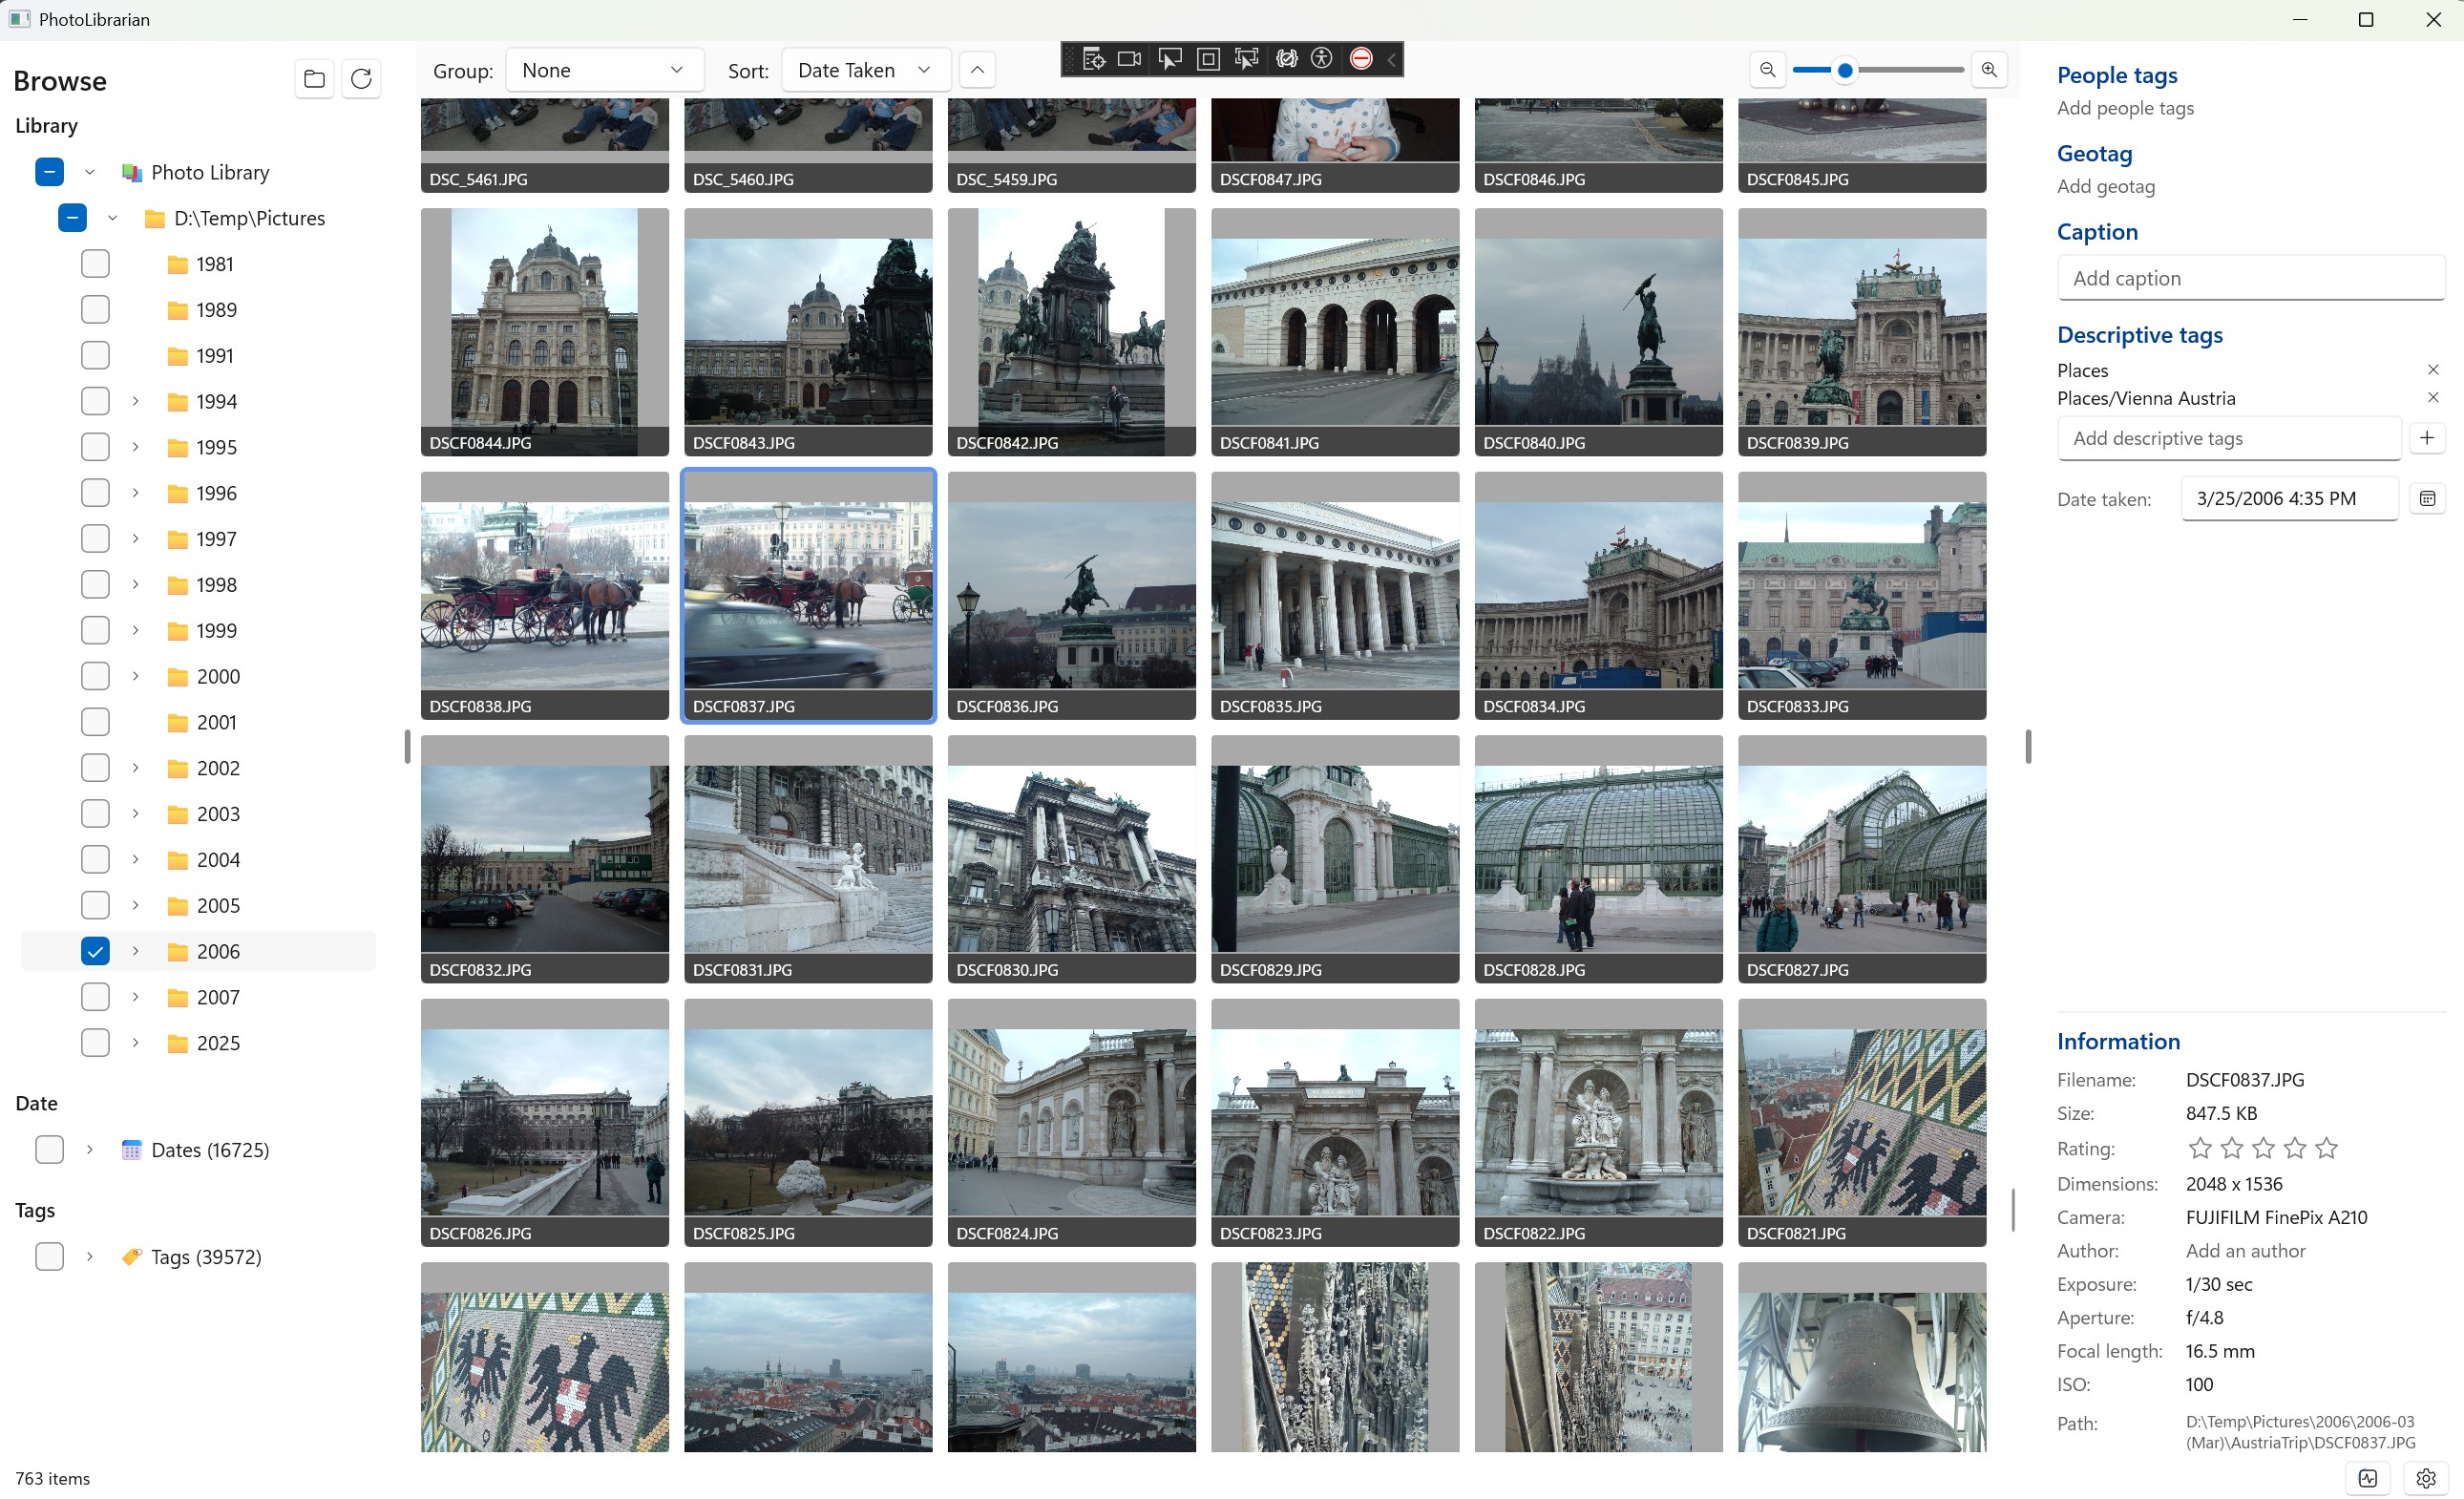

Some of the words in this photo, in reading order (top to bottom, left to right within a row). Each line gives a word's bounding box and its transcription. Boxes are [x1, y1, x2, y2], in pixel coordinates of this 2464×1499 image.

[39, 11, 150, 27] PhotoLibrarian
[433, 63, 494, 84] Group:
[523, 62, 571, 78] None
[728, 63, 769, 79] Sort:
[799, 62, 840, 78] Date
[844, 61, 895, 78] Taken
[2058, 65, 2128, 90] People
[2133, 67, 2179, 90] tags
[14, 70, 108, 92] Browse
[2056, 99, 2092, 116] Add
[2097, 99, 2155, 120] people
[2159, 101, 2195, 120] tags
[15, 116, 79, 138] Library
[2057, 144, 2133, 168] Geotag
[152, 163, 204, 180] Photo
[210, 162, 270, 185] Library
[430, 173, 528, 188] DSC_5461.JPG
[693, 173, 794, 188] DSC_5460.JPG
[957, 173, 1058, 188] DSC_5459.JPG
[1220, 173, 1322, 186] DSCF0847.JPG
[1484, 173, 1586, 186] DSCF0846.JPG
[1747, 173, 1849, 186] DSCF0845.JPG
[2056, 178, 2092, 194] Add
[2096, 179, 2156, 199] geotag
[175, 208, 326, 231] D:\Temp\Pictures
[2057, 222, 2138, 246] Caption
[197, 256, 233, 272] 1981
[2073, 269, 2110, 286] Add
[2116, 268, 2181, 291] caption
[197, 302, 238, 318] 1989
[2058, 325, 2174, 349] Descriptive
[2179, 327, 2224, 349] tags
[197, 348, 233, 364] 1991
[2057, 362, 2109, 378] Places
[197, 393, 238, 410] 1994
[2057, 390, 2173, 408] Places/Vienna
[2178, 391, 2236, 406] Austria
[197, 439, 238, 455] 1995
[430, 436, 532, 450] DSCF0844.JPG
[693, 436, 795, 450] DSCF0843.JPG
[957, 436, 1059, 450] DSCF0842.JPG
[1220, 436, 1319, 450] DSCF0841.JPG
[1484, 436, 1586, 450] DSCF0840.JPG
[1747, 436, 1849, 450] DSCF0839.JPG
[2073, 430, 2108, 446] Add
[2113, 430, 2203, 451] descriptive
[2207, 432, 2243, 451] tags
[197, 485, 238, 501] 1996
[2058, 492, 2096, 507] Date
[2101, 491, 2152, 507] taken:
[2197, 491, 2285, 508] 3/25/2006
[2288, 491, 2325, 506] 4:35
[2329, 491, 2356, 506] PM
[197, 531, 238, 547] 1997
[197, 577, 238, 593] 1998
[197, 623, 238, 639] 1999
[197, 668, 241, 685] 2000
[430, 700, 532, 713] DSCF0838.JPG
[693, 700, 795, 713] DSCF0837.JPG
[957, 700, 1059, 713] DSCF0836.JPG
[1220, 700, 1322, 713] DSCF0835.JPG
[1484, 700, 1586, 713] DSCF0834.JPG
[1747, 700, 1849, 713] DSCF0833.JPG
[197, 714, 236, 730] 2001
[197, 760, 241, 776] 2002
[197, 806, 241, 822] 2003
[197, 852, 242, 868] 2004
[197, 897, 241, 914] 2005
[197, 943, 241, 960] 2006
[430, 963, 532, 977] DSCF0832.JPG
[693, 963, 792, 977] DSCF0831.JPG
[957, 963, 1059, 977] DSCF0830.JPG
[1220, 963, 1322, 977] DSCF0829.JPG
[1484, 963, 1586, 977] DSCF0828.JPG
[1747, 963, 1849, 977] DSCF0827.JPG
[197, 989, 241, 1005] 2007
[197, 1035, 241, 1051] 2025
[2058, 1031, 2180, 1050] Information
[2057, 1071, 2136, 1087] Filename:
[2186, 1072, 2305, 1087] DSCF0837.JPG
[15, 1095, 58, 1111] Date
[2057, 1106, 2095, 1121] Size:
[2186, 1106, 2231, 1121] 847.5
[2236, 1106, 2258, 1121] KB
[152, 1142, 201, 1158] Dates
[207, 1142, 270, 1161] (16725)
[2057, 1141, 2116, 1161] Rating:
[2058, 1176, 2159, 1192] Dimensions:
[2186, 1176, 2227, 1192] 2048
[2231, 1180, 2242, 1192] x
[2244, 1176, 2284, 1192] 1536
[14, 1202, 55, 1223] Tags
[2057, 1210, 2125, 1225] Camera:
[2186, 1210, 2260, 1225] FUJIFILM
[2265, 1210, 2324, 1225] FinePix
[2327, 1210, 2369, 1225] A210
[430, 1227, 532, 1240] DSCF0826.JPG
[693, 1227, 795, 1240] DSCF0825.JPG
[957, 1227, 1059, 1240] DSCF0824.JPG
[1220, 1227, 1322, 1240] DSCF0823.JPG
[1484, 1227, 1586, 1240] DSCF0822.JPG
[1747, 1227, 1846, 1240] DSCF0821.JPG
[2056, 1242, 2119, 1258] Author:
[2185, 1242, 2221, 1258] Add
[2225, 1247, 2245, 1258] an
[2251, 1242, 2306, 1258] author
[151, 1249, 191, 1270] Tags
[196, 1249, 262, 1268] (39572)
[2058, 1277, 2137, 1297] Exposure:
[2185, 1277, 2222, 1294] 1/30
[2225, 1280, 2253, 1292] sec
[2056, 1310, 2135, 1330] Aperture:
[2185, 1309, 2224, 1327] f/4.8
[2058, 1342, 2100, 1359] Focal
[2106, 1342, 2163, 1363] length:
[2185, 1343, 2219, 1359] 16.5
[2223, 1347, 2256, 1359] mm
[2058, 1377, 2091, 1392] ISO:
[2185, 1377, 2214, 1392] 100
[2057, 1415, 2098, 1431] Path:
[2186, 1414, 2415, 1432] D:\Temp\Pictures\2006\2006-03
[2186, 1435, 2416, 1453] (Mar)\AustriaTrip\DSCF0837.JPG
[15, 1471, 44, 1486] 763
[49, 1471, 91, 1486] items
